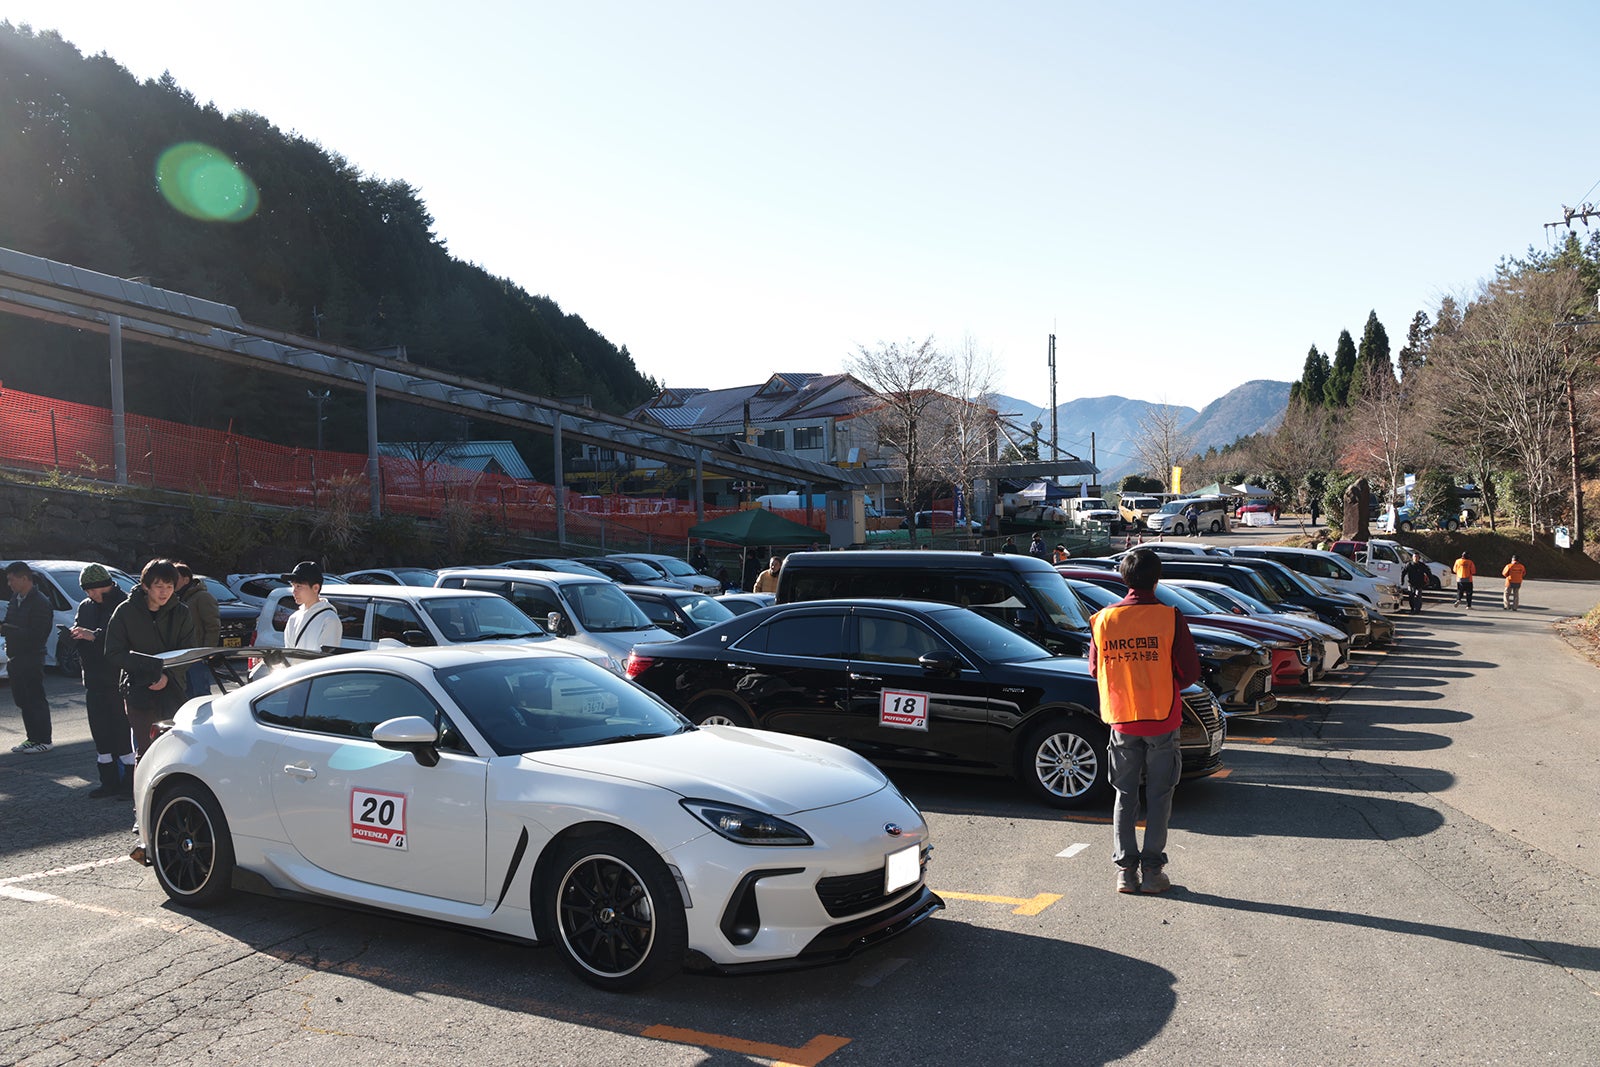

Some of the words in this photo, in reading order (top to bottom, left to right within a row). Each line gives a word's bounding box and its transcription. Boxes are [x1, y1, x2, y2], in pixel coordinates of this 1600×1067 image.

[1103, 636, 1158, 652] JMRC四国
[1104, 650, 1158, 664] オートテスト部会
[893, 697, 916, 714] 18
[883, 715, 912, 723] POTENZA
[359, 797, 395, 826] 20
[353, 828, 388, 840] POTENZA
